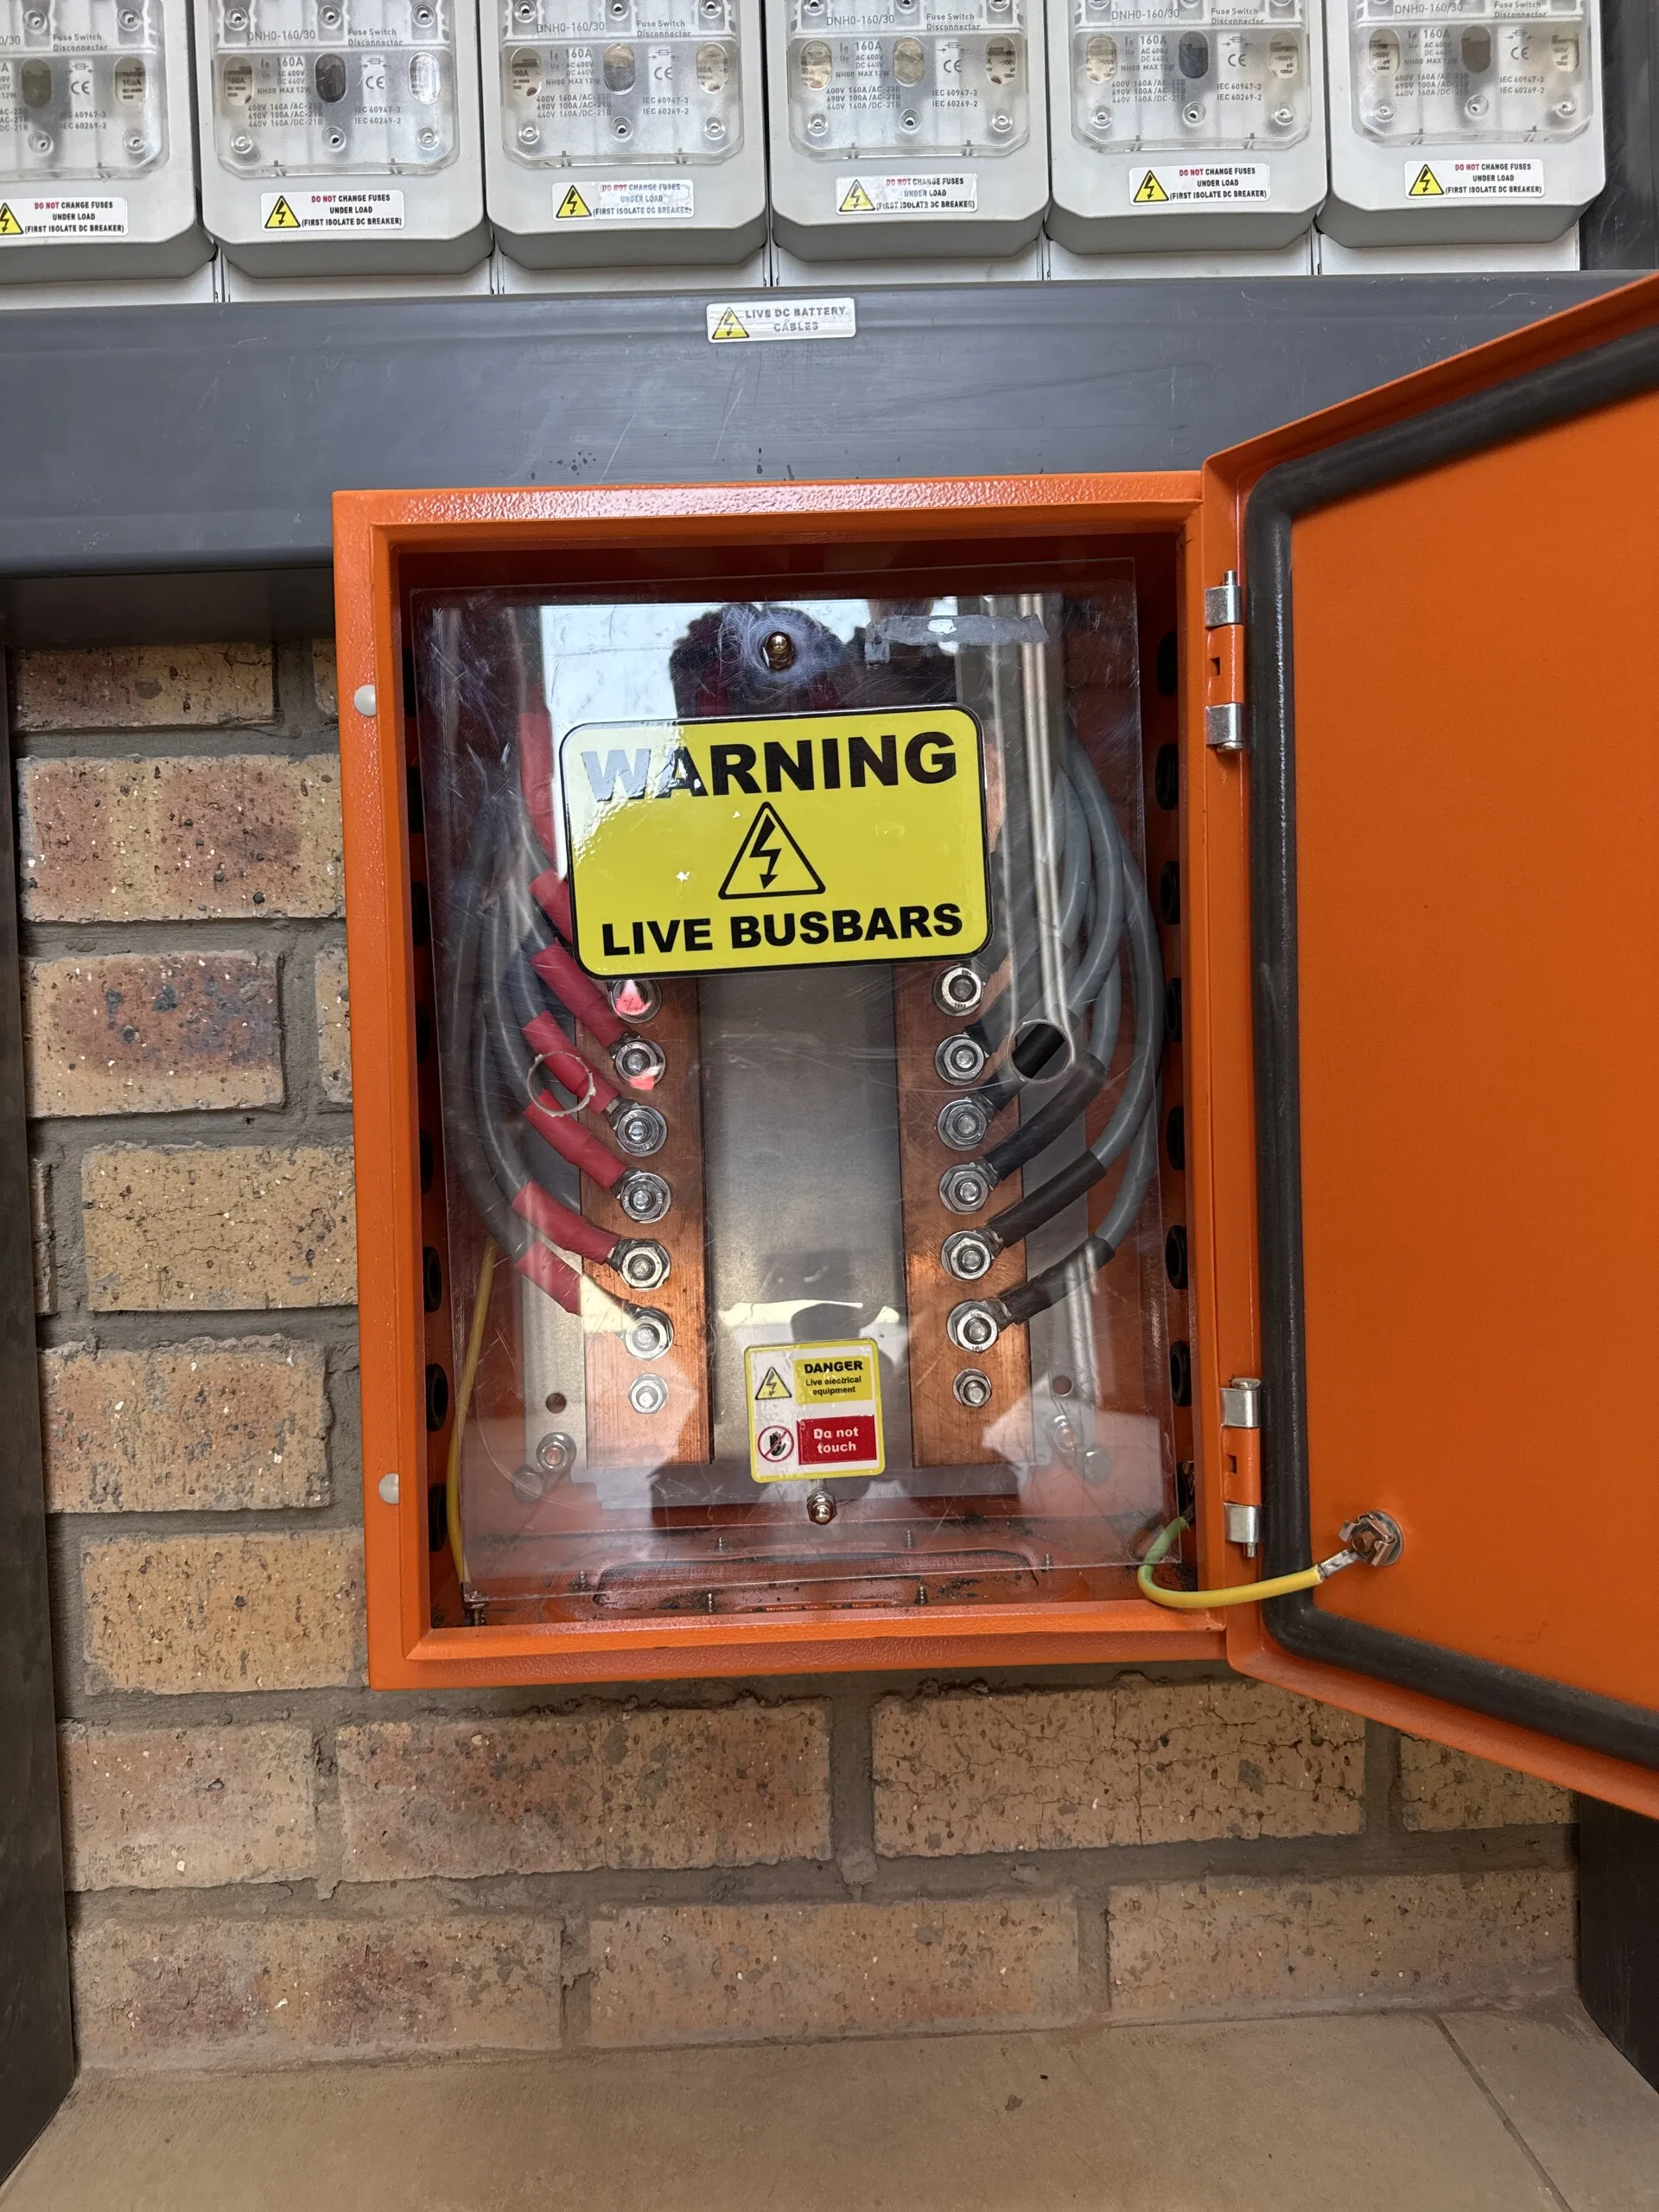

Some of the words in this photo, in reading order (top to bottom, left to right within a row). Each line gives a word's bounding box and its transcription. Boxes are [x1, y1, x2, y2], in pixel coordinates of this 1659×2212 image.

[1395, 3, 1463, 14] DNH0-160/30
[827, 14, 894, 26] DNH0-160/30
[1112, 9, 1179, 20] DNH0-160/30
[537, 22, 604, 33] DNH0-160/30
[247, 29, 315, 41] DNH0-160/30
[1141, 35, 1167, 44] 160A
[855, 41, 882, 51] 160A
[566, 48, 592, 59] 160A
[276, 57, 303, 67] 160A
[1170, 192, 1192, 200] (FIRST
[1234, 190, 1267, 199] BREAKER)
[593, 207, 614, 216] (FIRST
[25, 226, 47, 234] (FIRST
[90, 225, 124, 233] BREAKER)
[746, 309, 771, 319] LIVE
[775, 308, 790, 317] DC
[793, 306, 846, 316] BATTERY
[773, 321, 818, 332] CABLES
[582, 731, 957, 802] WARNING
[601, 918, 713, 957] LIVE
[730, 903, 963, 950] BUSBARS
[804, 1360, 863, 1374] DANGER
[824, 1376, 861, 1385] electrical
[812, 1386, 855, 1395] equipment
[814, 1428, 832, 1439] Do
[836, 1427, 859, 1438] not
[817, 1441, 856, 1453] touch
